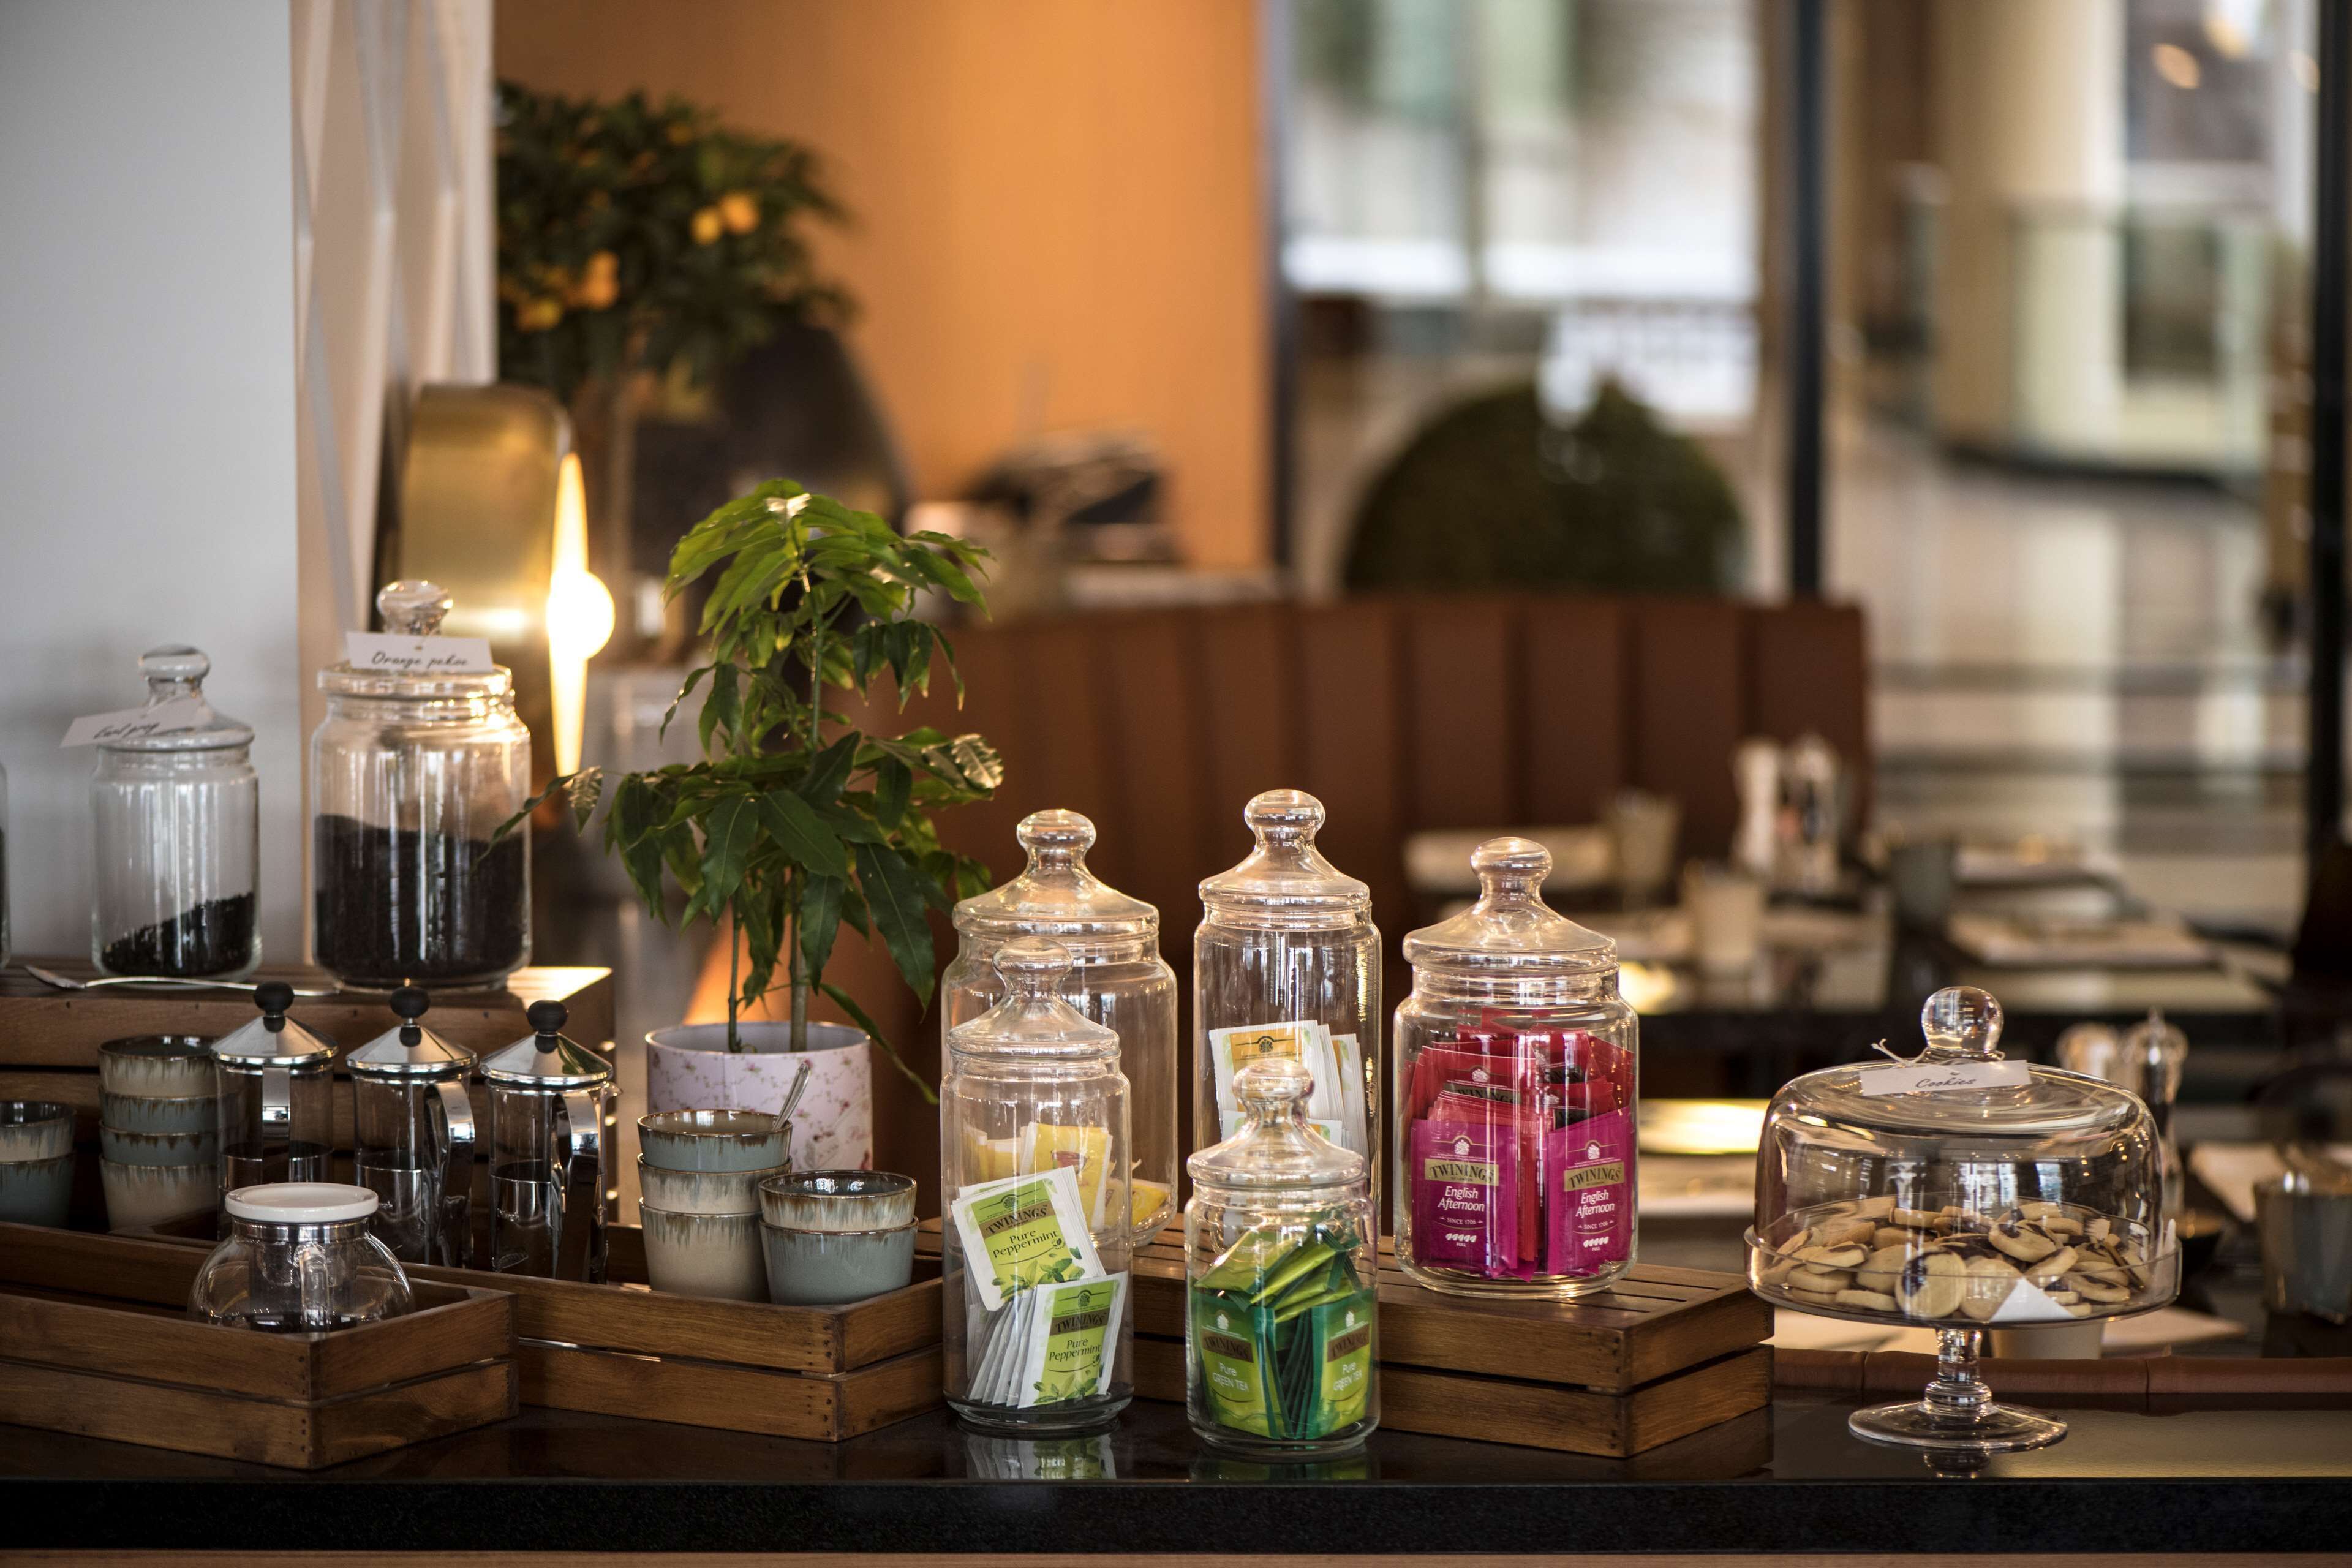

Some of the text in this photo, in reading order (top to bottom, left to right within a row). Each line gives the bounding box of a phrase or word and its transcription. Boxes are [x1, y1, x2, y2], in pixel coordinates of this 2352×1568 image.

[371, 650, 422, 669] Orange
[1915, 1077, 1977, 1088] Cookies
[1430, 1163, 1494, 1183] TWININGS
[1568, 1167, 1620, 1188] TWININGS
[1444, 1185, 1479, 1200] English
[1581, 1189, 1609, 1205] English
[1437, 1197, 1485, 1212] Afternoon
[1575, 1202, 1615, 1219] Afternoon
[985, 1207, 1047, 1234] TWININGS
[992, 1230, 1058, 1259] Peppermint
[1009, 1230, 1037, 1245] Pure
[1055, 1313, 1104, 1333] TWININGS
[1066, 1338, 1088, 1349] Pure
[1049, 1344, 1102, 1363] Peppermint
[1219, 1362, 1237, 1377] Pure
[1212, 1372, 1249, 1392] GREEN TEA
